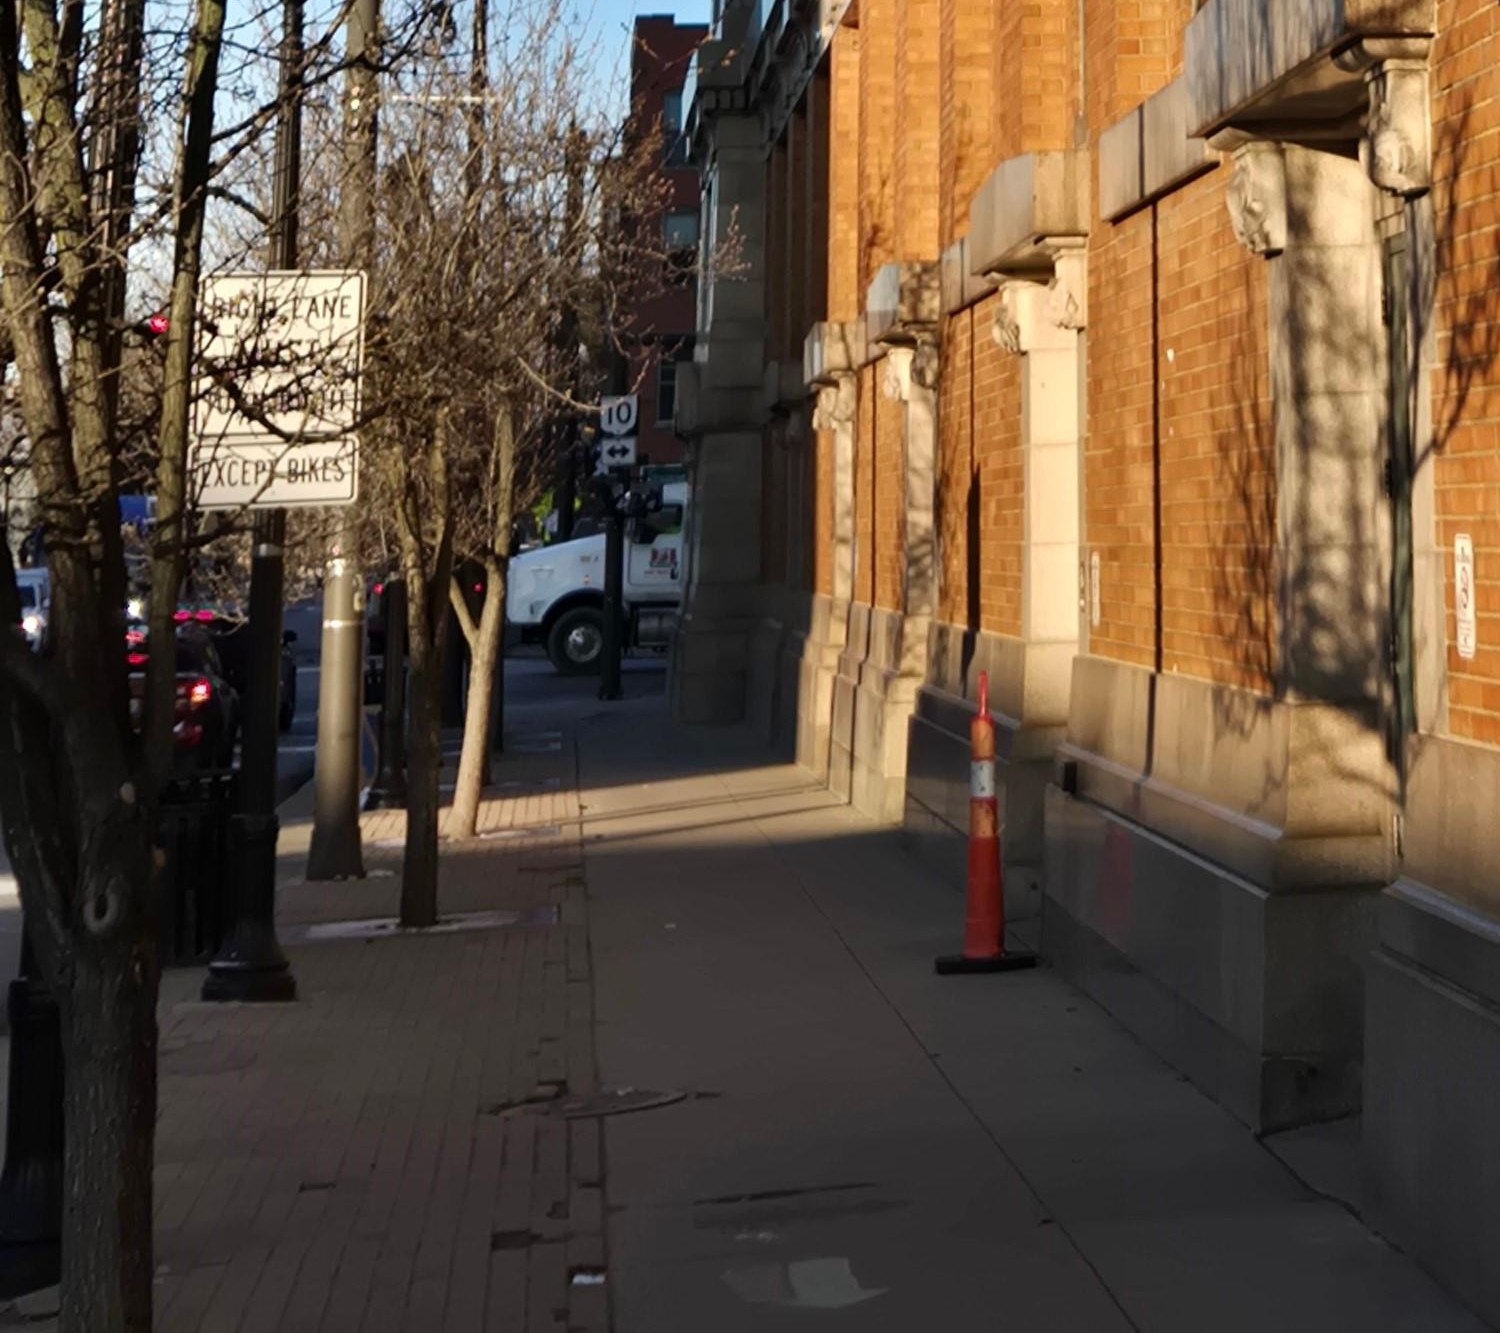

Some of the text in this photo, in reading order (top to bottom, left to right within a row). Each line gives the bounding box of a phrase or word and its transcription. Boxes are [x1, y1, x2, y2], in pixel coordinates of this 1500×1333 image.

[292, 295, 352, 319] LANE
[605, 401, 632, 425] 10
[200, 456, 346, 488] EXCEPT BIKES
